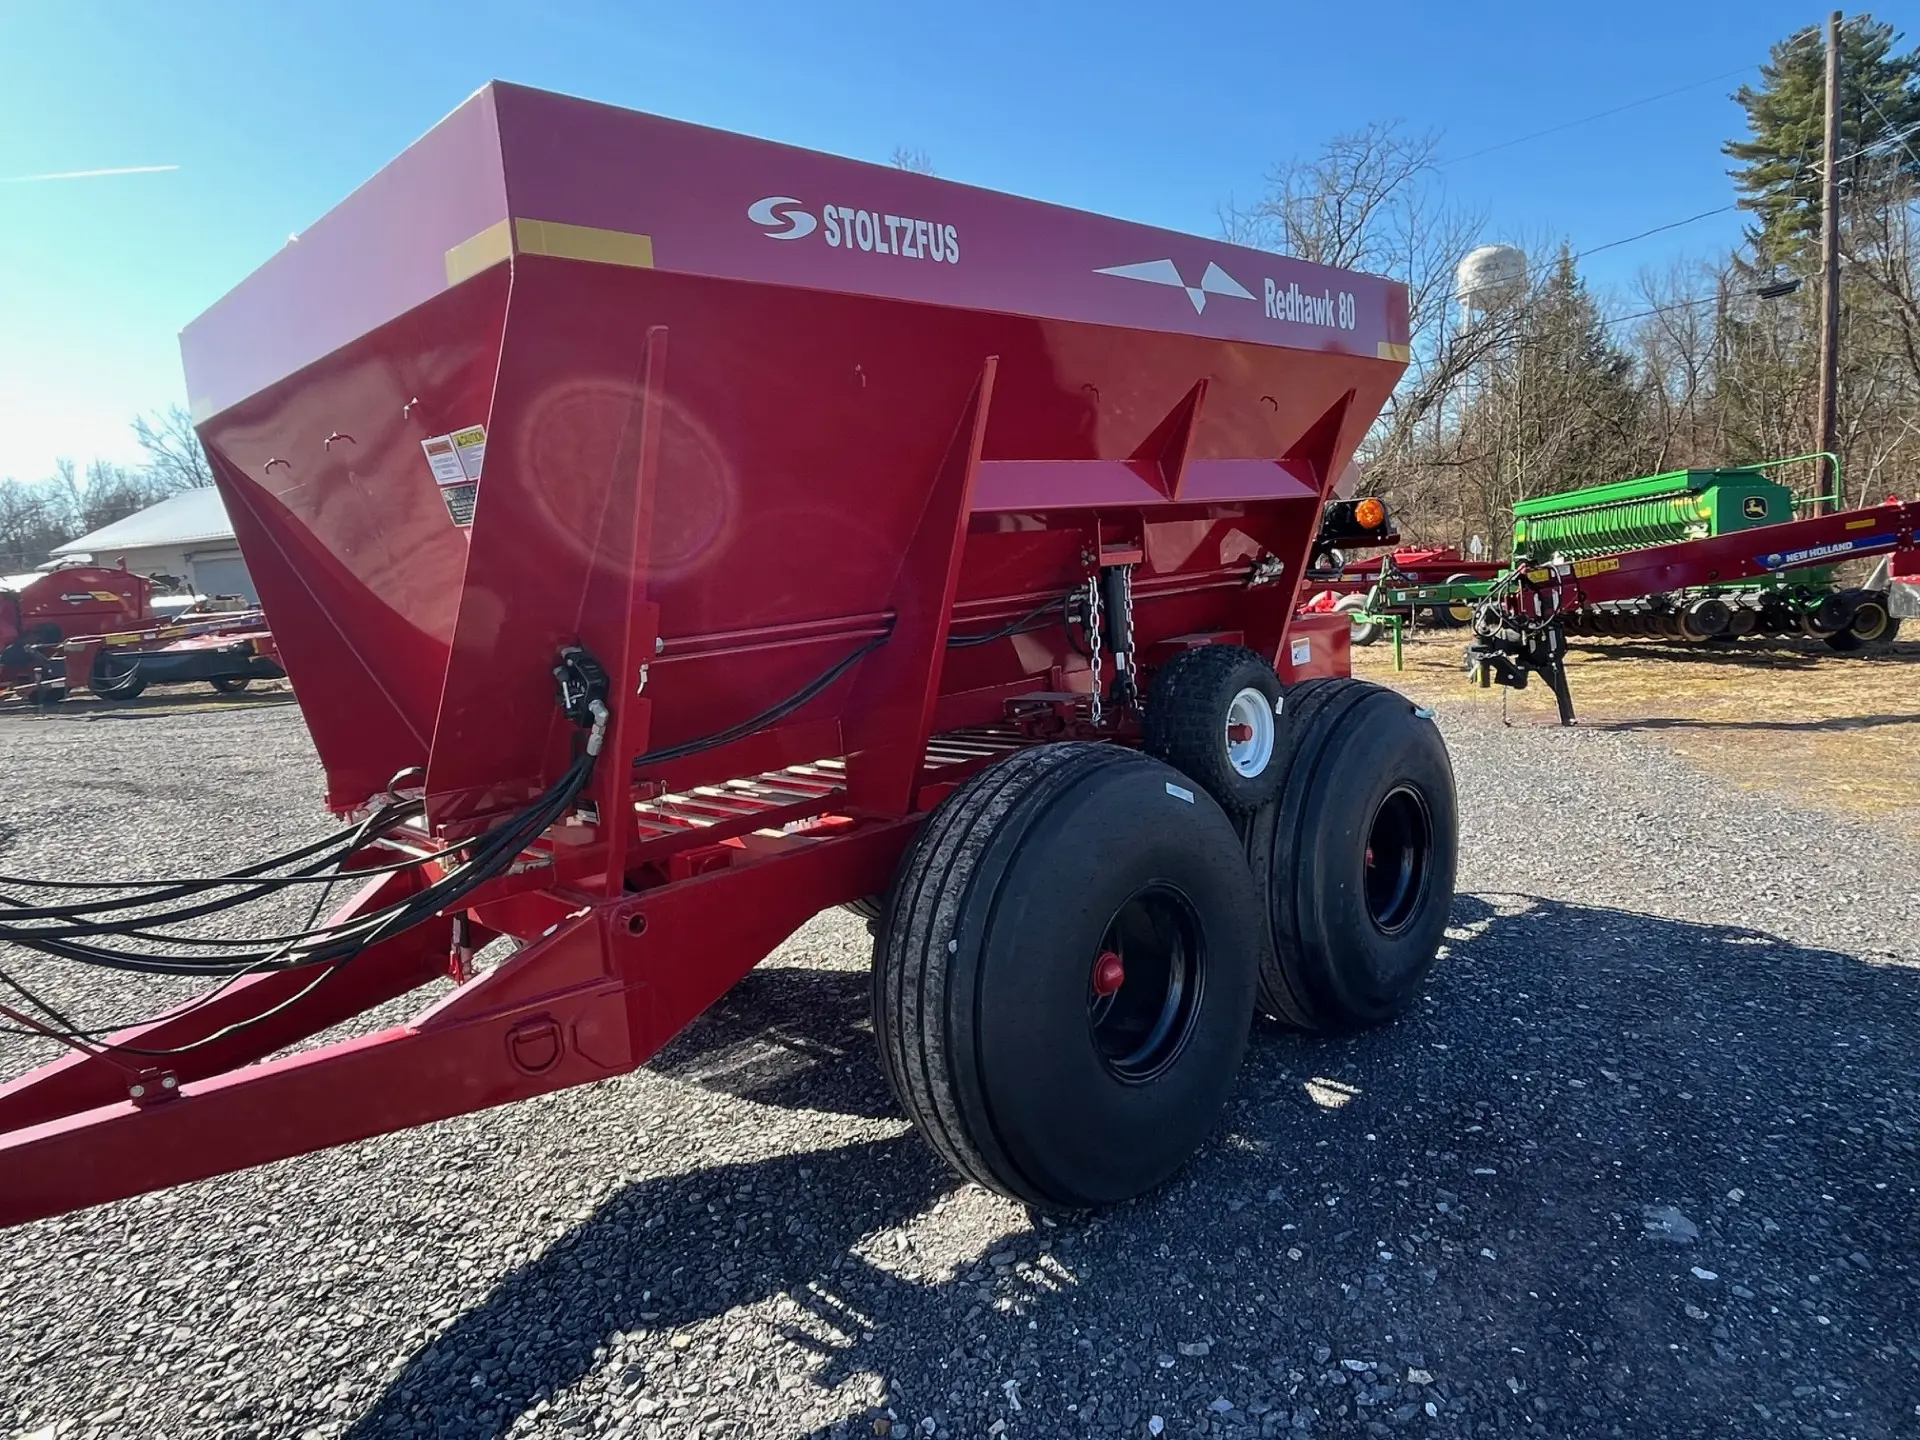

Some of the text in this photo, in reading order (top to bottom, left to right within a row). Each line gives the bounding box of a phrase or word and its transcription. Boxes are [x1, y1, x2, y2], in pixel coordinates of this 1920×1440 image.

[823, 204, 960, 264] STOLTZFUS
[1264, 277, 1356, 331] Redhawk 80
[1785, 541, 1854, 563] NEW HOLLAND
